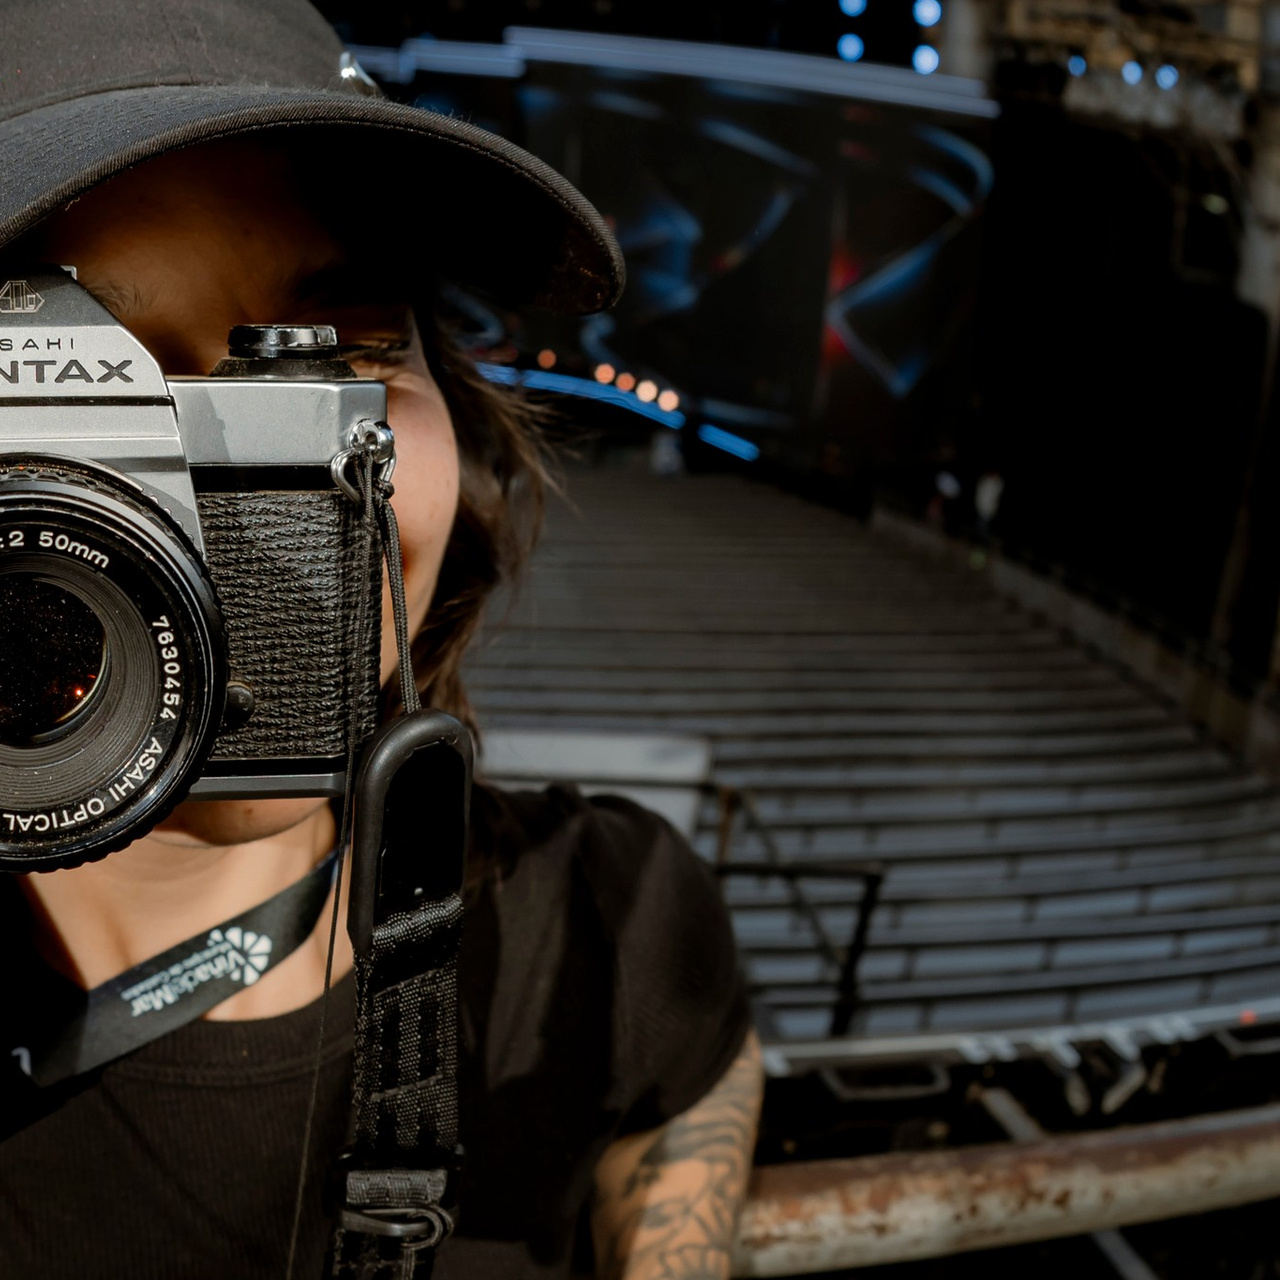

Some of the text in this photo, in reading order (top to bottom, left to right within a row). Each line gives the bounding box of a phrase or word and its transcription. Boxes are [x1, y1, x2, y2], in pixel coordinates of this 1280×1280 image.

[38, 530, 110, 569] 50mm
[151, 614, 181, 721] 7630454
[108, 737, 164, 803] ASAHI
[2, 796, 106, 832] OPTICAL
